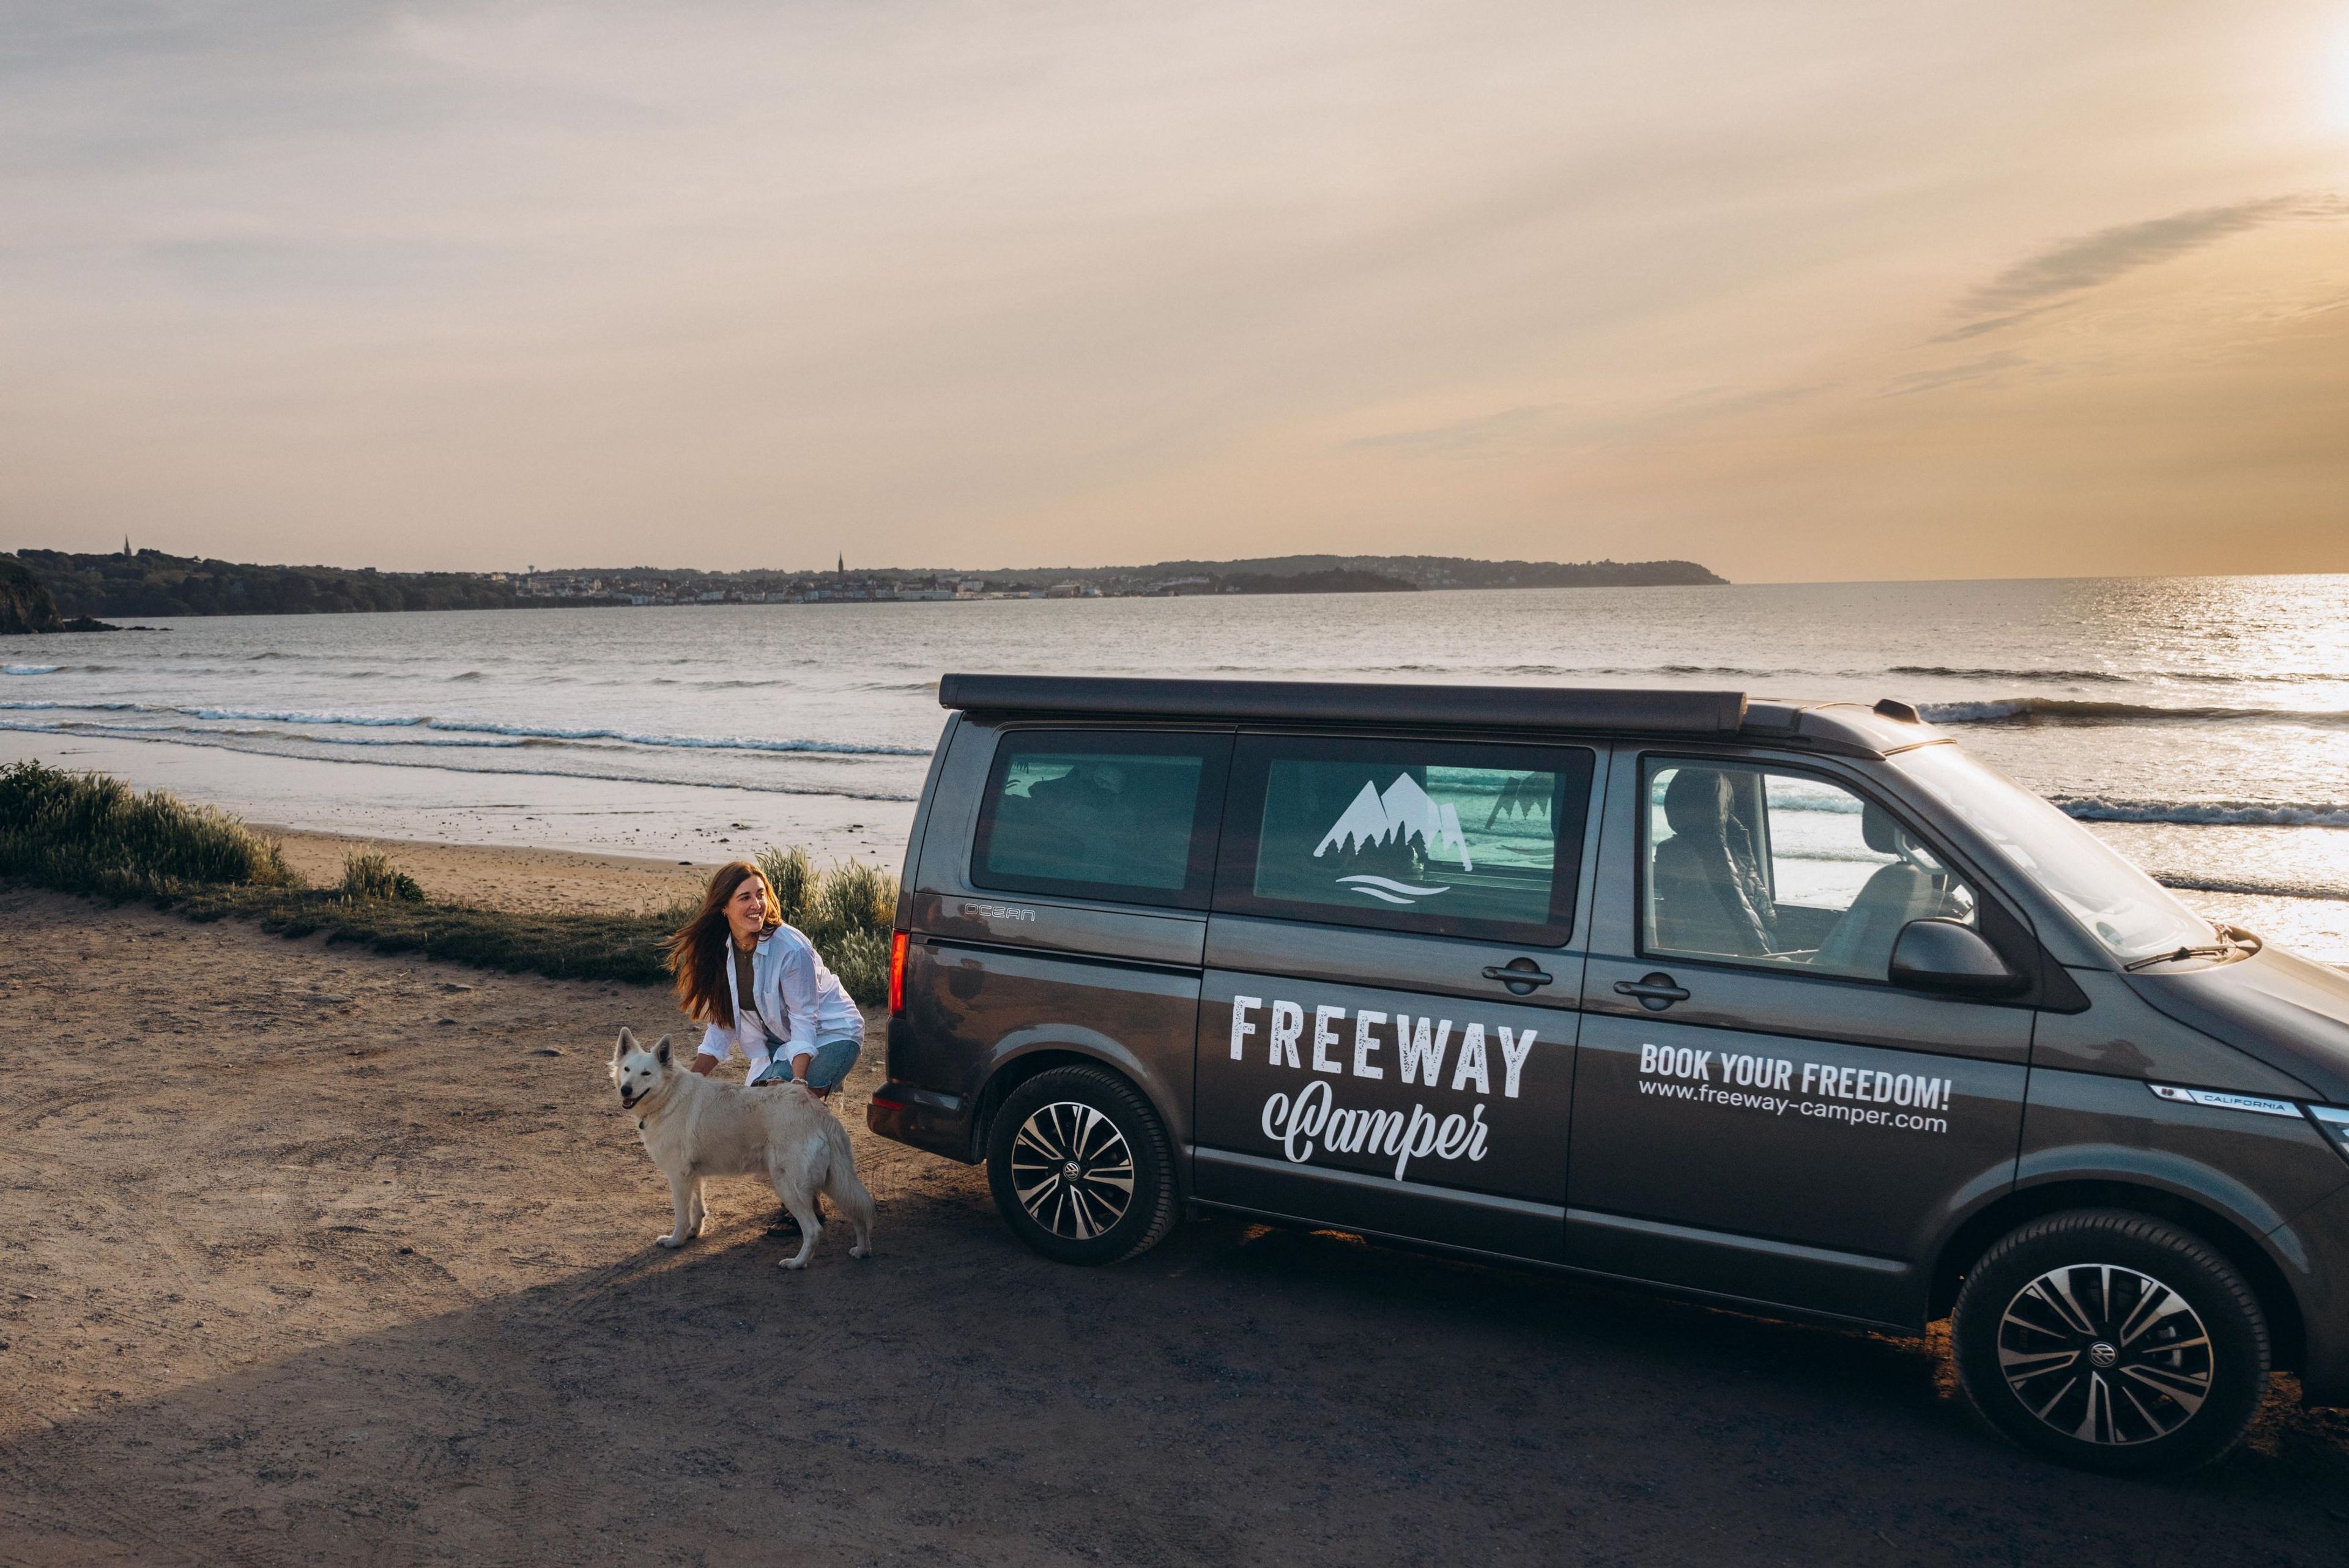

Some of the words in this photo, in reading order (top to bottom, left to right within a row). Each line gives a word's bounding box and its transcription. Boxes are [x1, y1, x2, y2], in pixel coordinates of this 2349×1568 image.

[965, 904, 1035, 921] OCEAN
[1231, 996, 1538, 1098] FREEWAY
[1640, 1043, 1712, 1081] BOOK
[1721, 1053, 1792, 1091] YOUR
[1802, 1063, 1951, 1111] FREEDOM!
[1262, 1081, 1488, 1180] Camper
[1639, 1081, 1947, 1133] www.freeway-camper.com
[2205, 1095, 2285, 1111] CALIFORNIA
